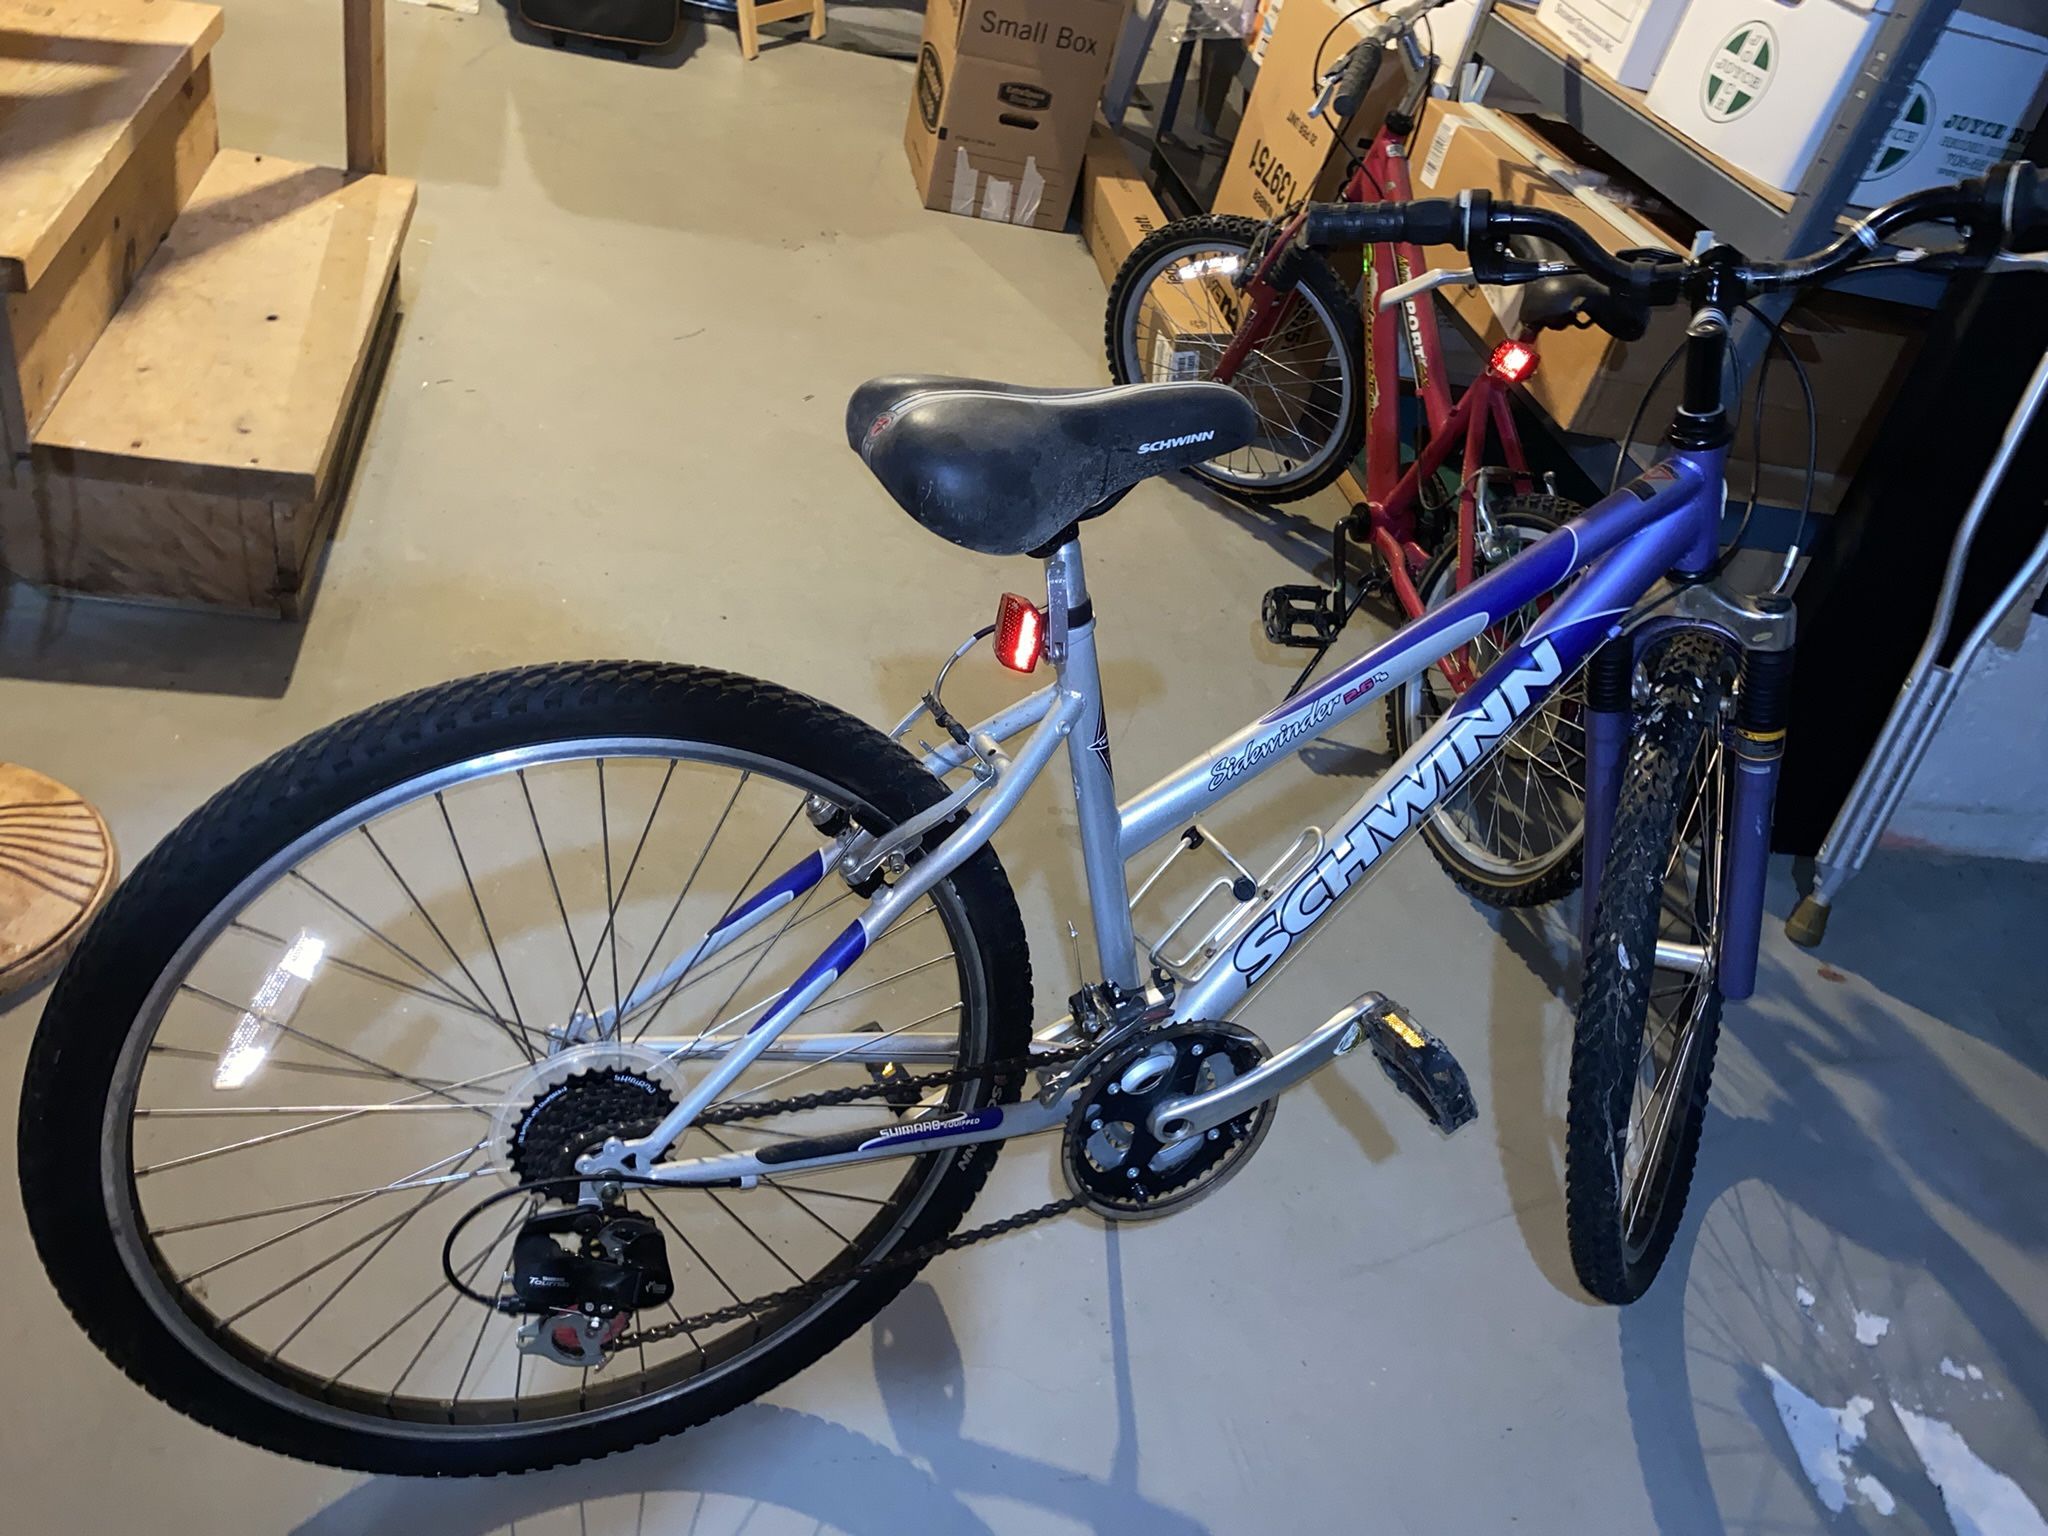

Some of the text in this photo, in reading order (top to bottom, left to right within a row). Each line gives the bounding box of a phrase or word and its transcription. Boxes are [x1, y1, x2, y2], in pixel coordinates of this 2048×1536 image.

[980, 10, 1098, 56] Small Box
[1943, 114, 2008, 139] JOYCE
[1136, 429, 1215, 455] SCHWINN
[1207, 692, 1342, 793] Sidewinder
[1233, 637, 1564, 988] SCHWINN
